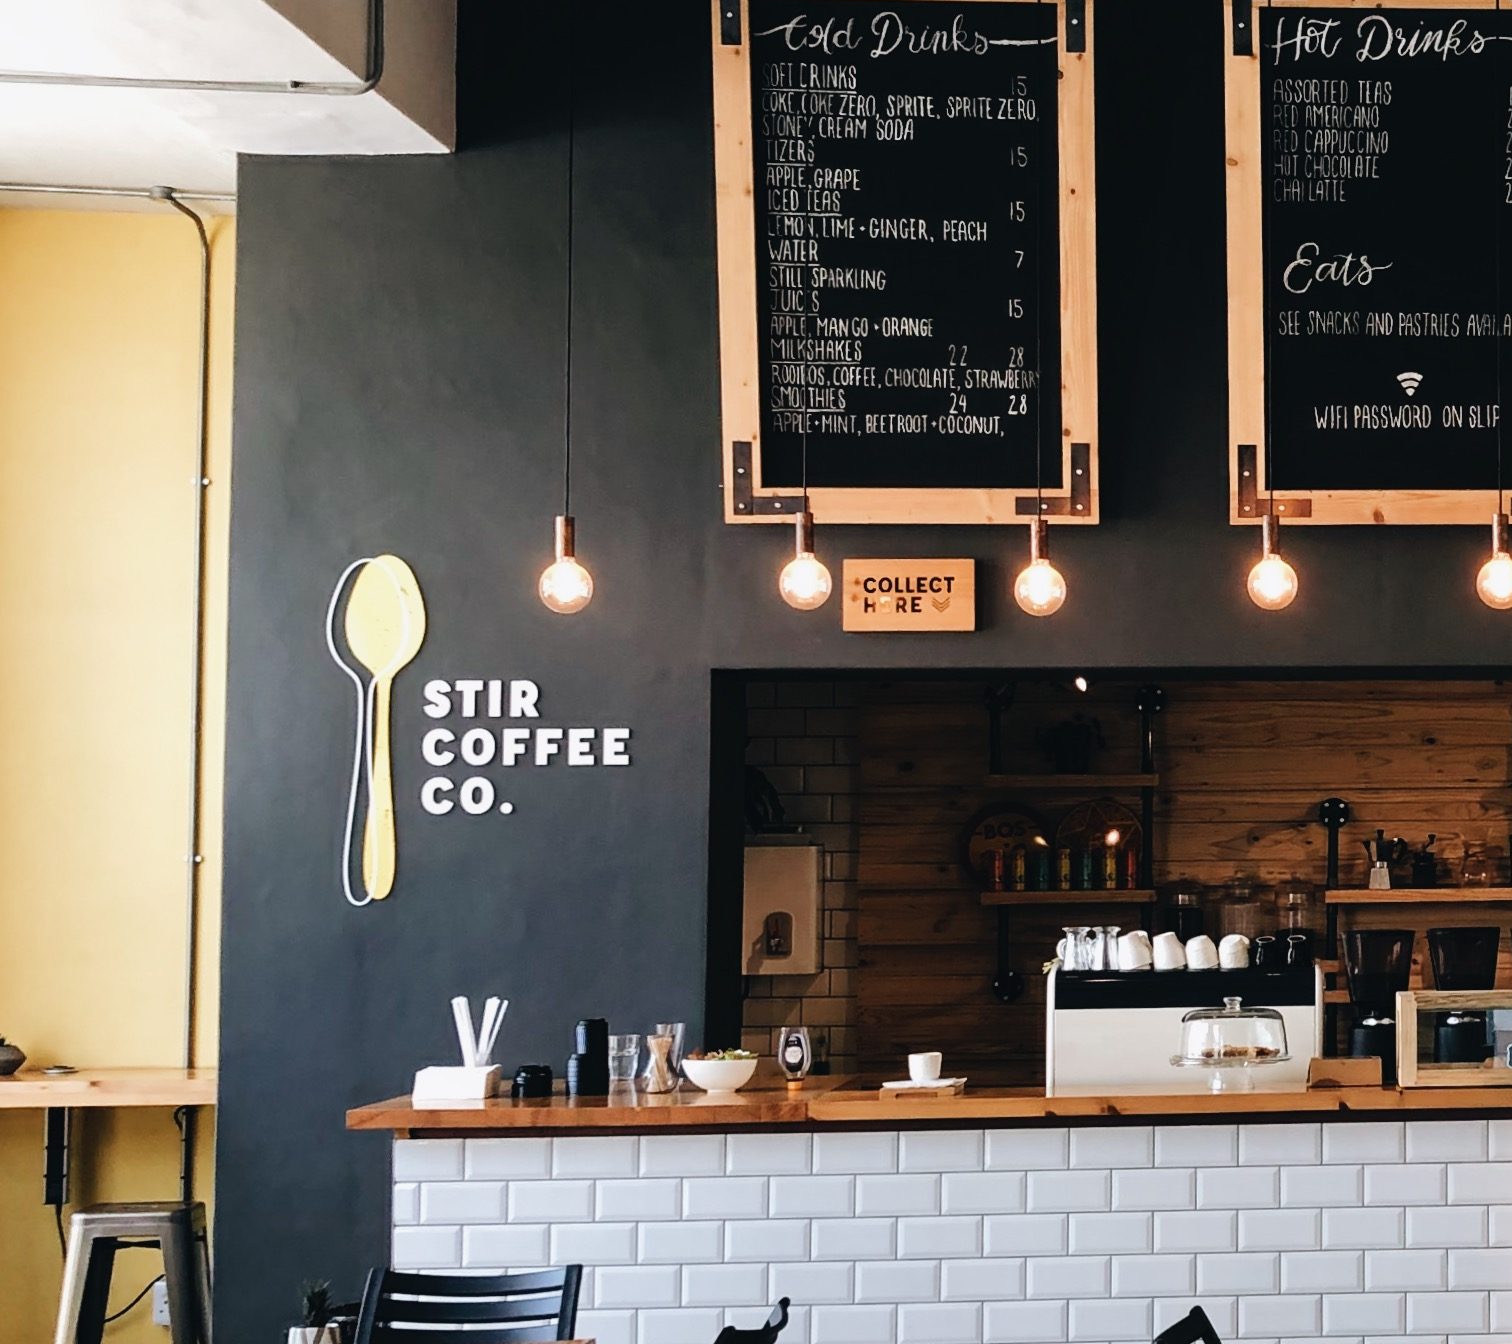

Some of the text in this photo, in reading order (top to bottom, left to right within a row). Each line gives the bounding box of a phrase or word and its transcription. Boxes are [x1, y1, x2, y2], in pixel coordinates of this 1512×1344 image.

[783, 11, 989, 59] Cold Drinks
[1272, 15, 1488, 66] Hot Drinks
[762, 64, 1027, 96] SOFT DRINKS 15
[1273, 79, 1348, 104] ASSORTED
[1358, 80, 1392, 105] TEAS
[762, 94, 799, 116] COKE,
[840, 96, 879, 119] ZERO,
[946, 96, 992, 120] SPRITE
[1273, 105, 1299, 129] RED
[1305, 106, 1380, 129] AMERICANO
[819, 118, 867, 140] CREAM
[876, 119, 914, 141] SODA
[1273, 129, 1299, 152] RED
[1304, 129, 1389, 154] CAPPUCCINO
[1010, 147, 1028, 167] 15
[1273, 155, 1300, 178] HOT
[1304, 155, 1380, 179] CHOCOLATE
[814, 169, 860, 191] GRAPE
[1273, 179, 1304, 203] CHAI
[1308, 180, 1347, 203] LATTE
[768, 190, 1025, 222] ICED TEAS 15
[943, 220, 987, 241] PEACH
[769, 241, 1024, 269] WATER 7
[1283, 242, 1393, 294] Eats
[812, 268, 886, 290] SPARKLING
[771, 290, 1024, 318] JUICS 15
[1278, 311, 1301, 336] SEE
[1306, 311, 1360, 336] SNACKS
[1366, 312, 1393, 337] AND
[1398, 312, 1460, 337] PASTRIES
[770, 340, 1024, 368] MILKSHAKES 22 28
[771, 388, 1027, 415] SMOOTHIES 24 28
[1314, 404, 1348, 429] WIFI
[1354, 404, 1432, 429] PASSWORD
[1442, 405, 1463, 428] ON
[863, 576, 955, 593] COLLECT
[864, 596, 922, 613] HRE
[423, 679, 539, 718] STIR
[422, 728, 630, 766] COFFEE
[420, 776, 514, 815] CO.
